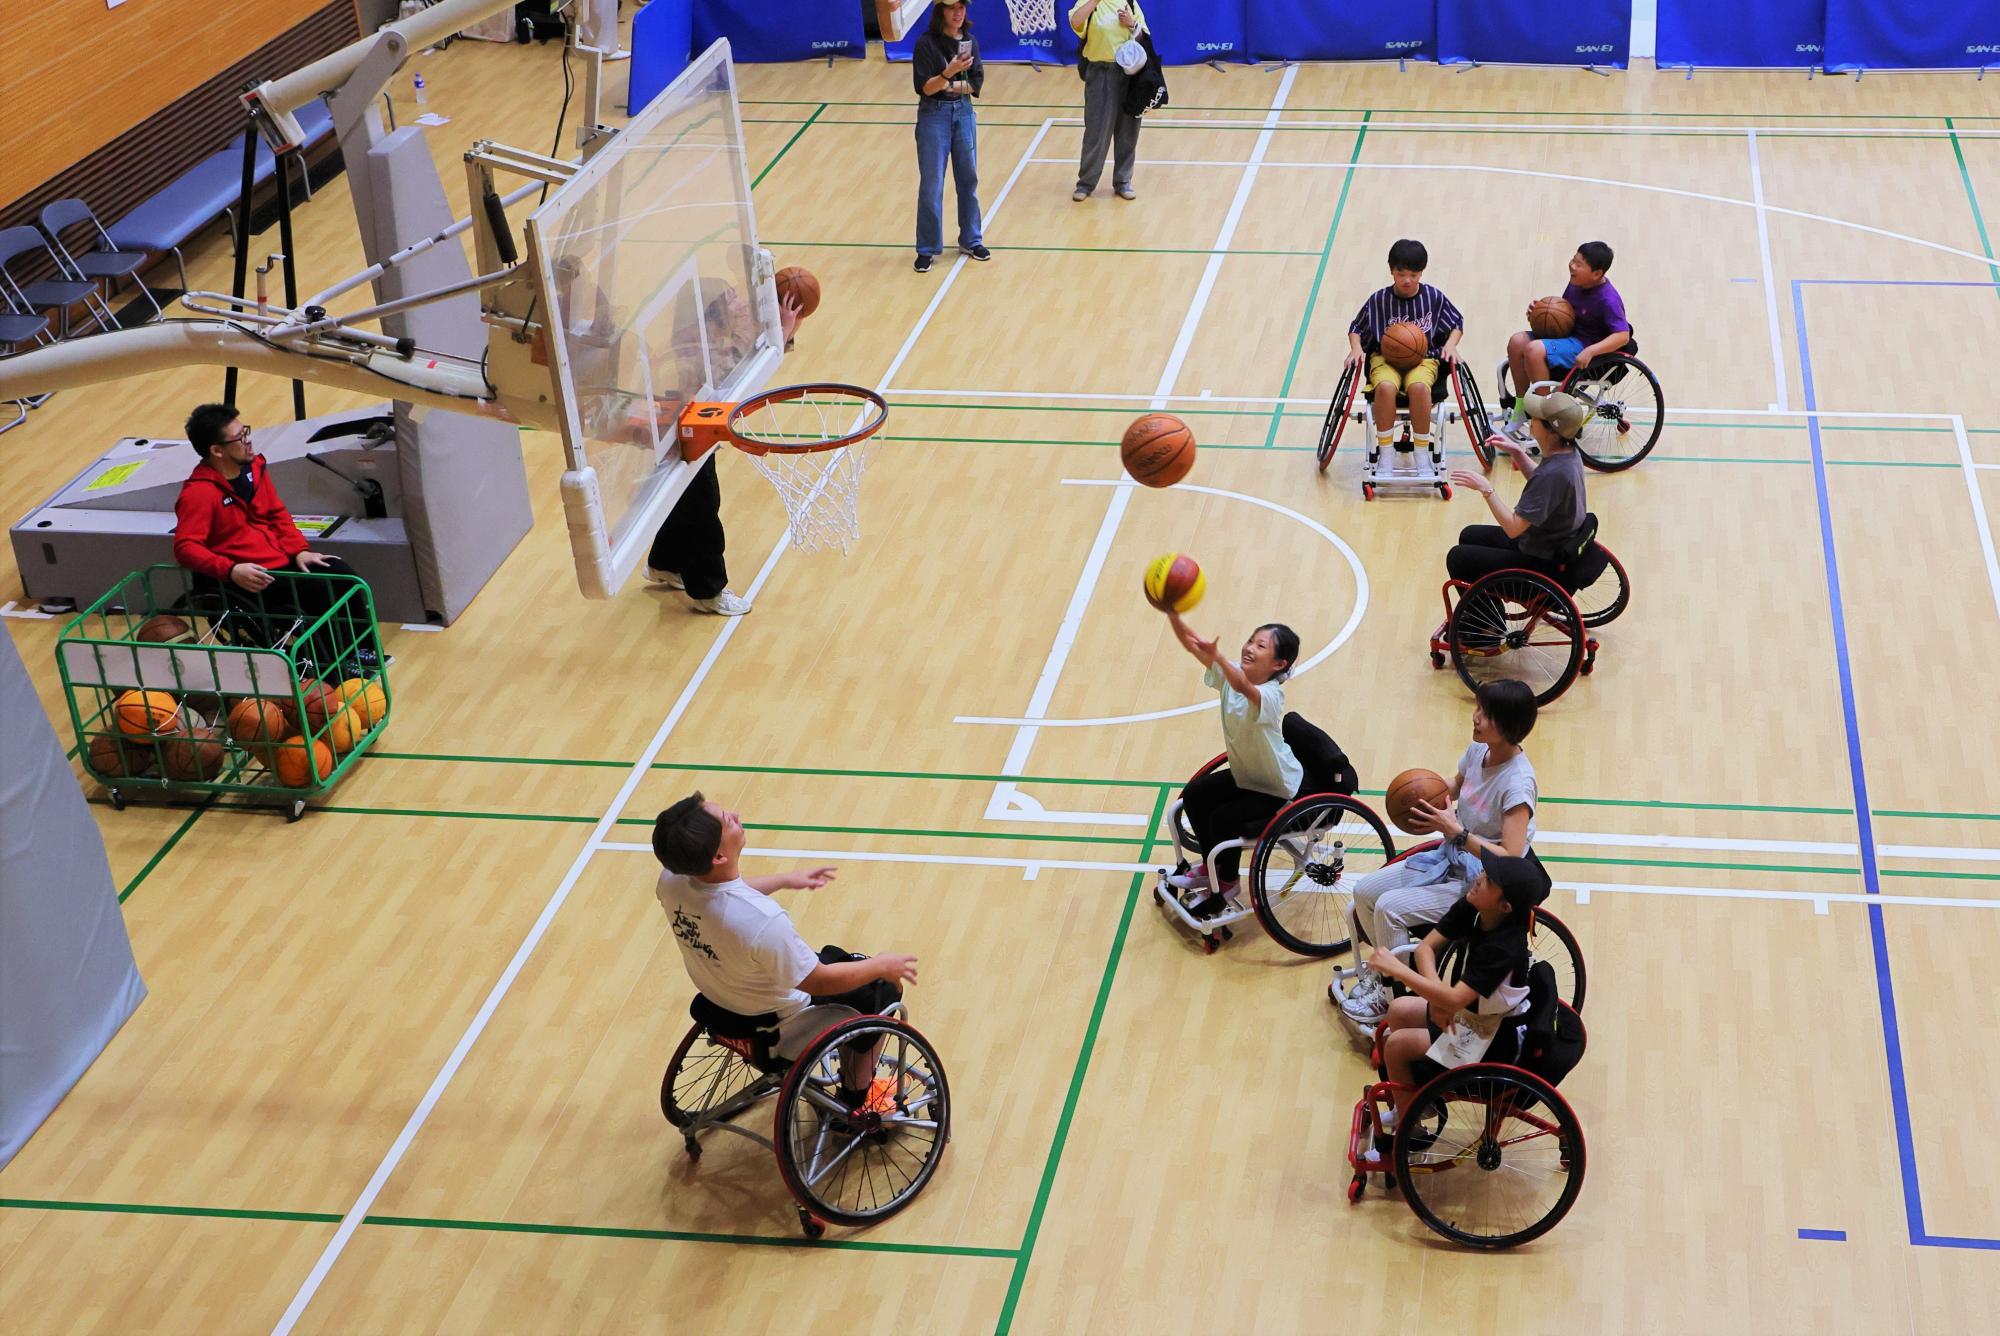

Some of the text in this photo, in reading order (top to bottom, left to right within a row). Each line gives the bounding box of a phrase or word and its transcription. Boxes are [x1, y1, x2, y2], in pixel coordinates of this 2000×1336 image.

[811, 40, 849, 49] SAN-EI
[1018, 38, 1053, 48] SAN-EI
[1196, 42, 1234, 51] SAN-EI
[1385, 40, 1423, 49] SAN-EI
[1575, 44, 1614, 53] SAN-EI
